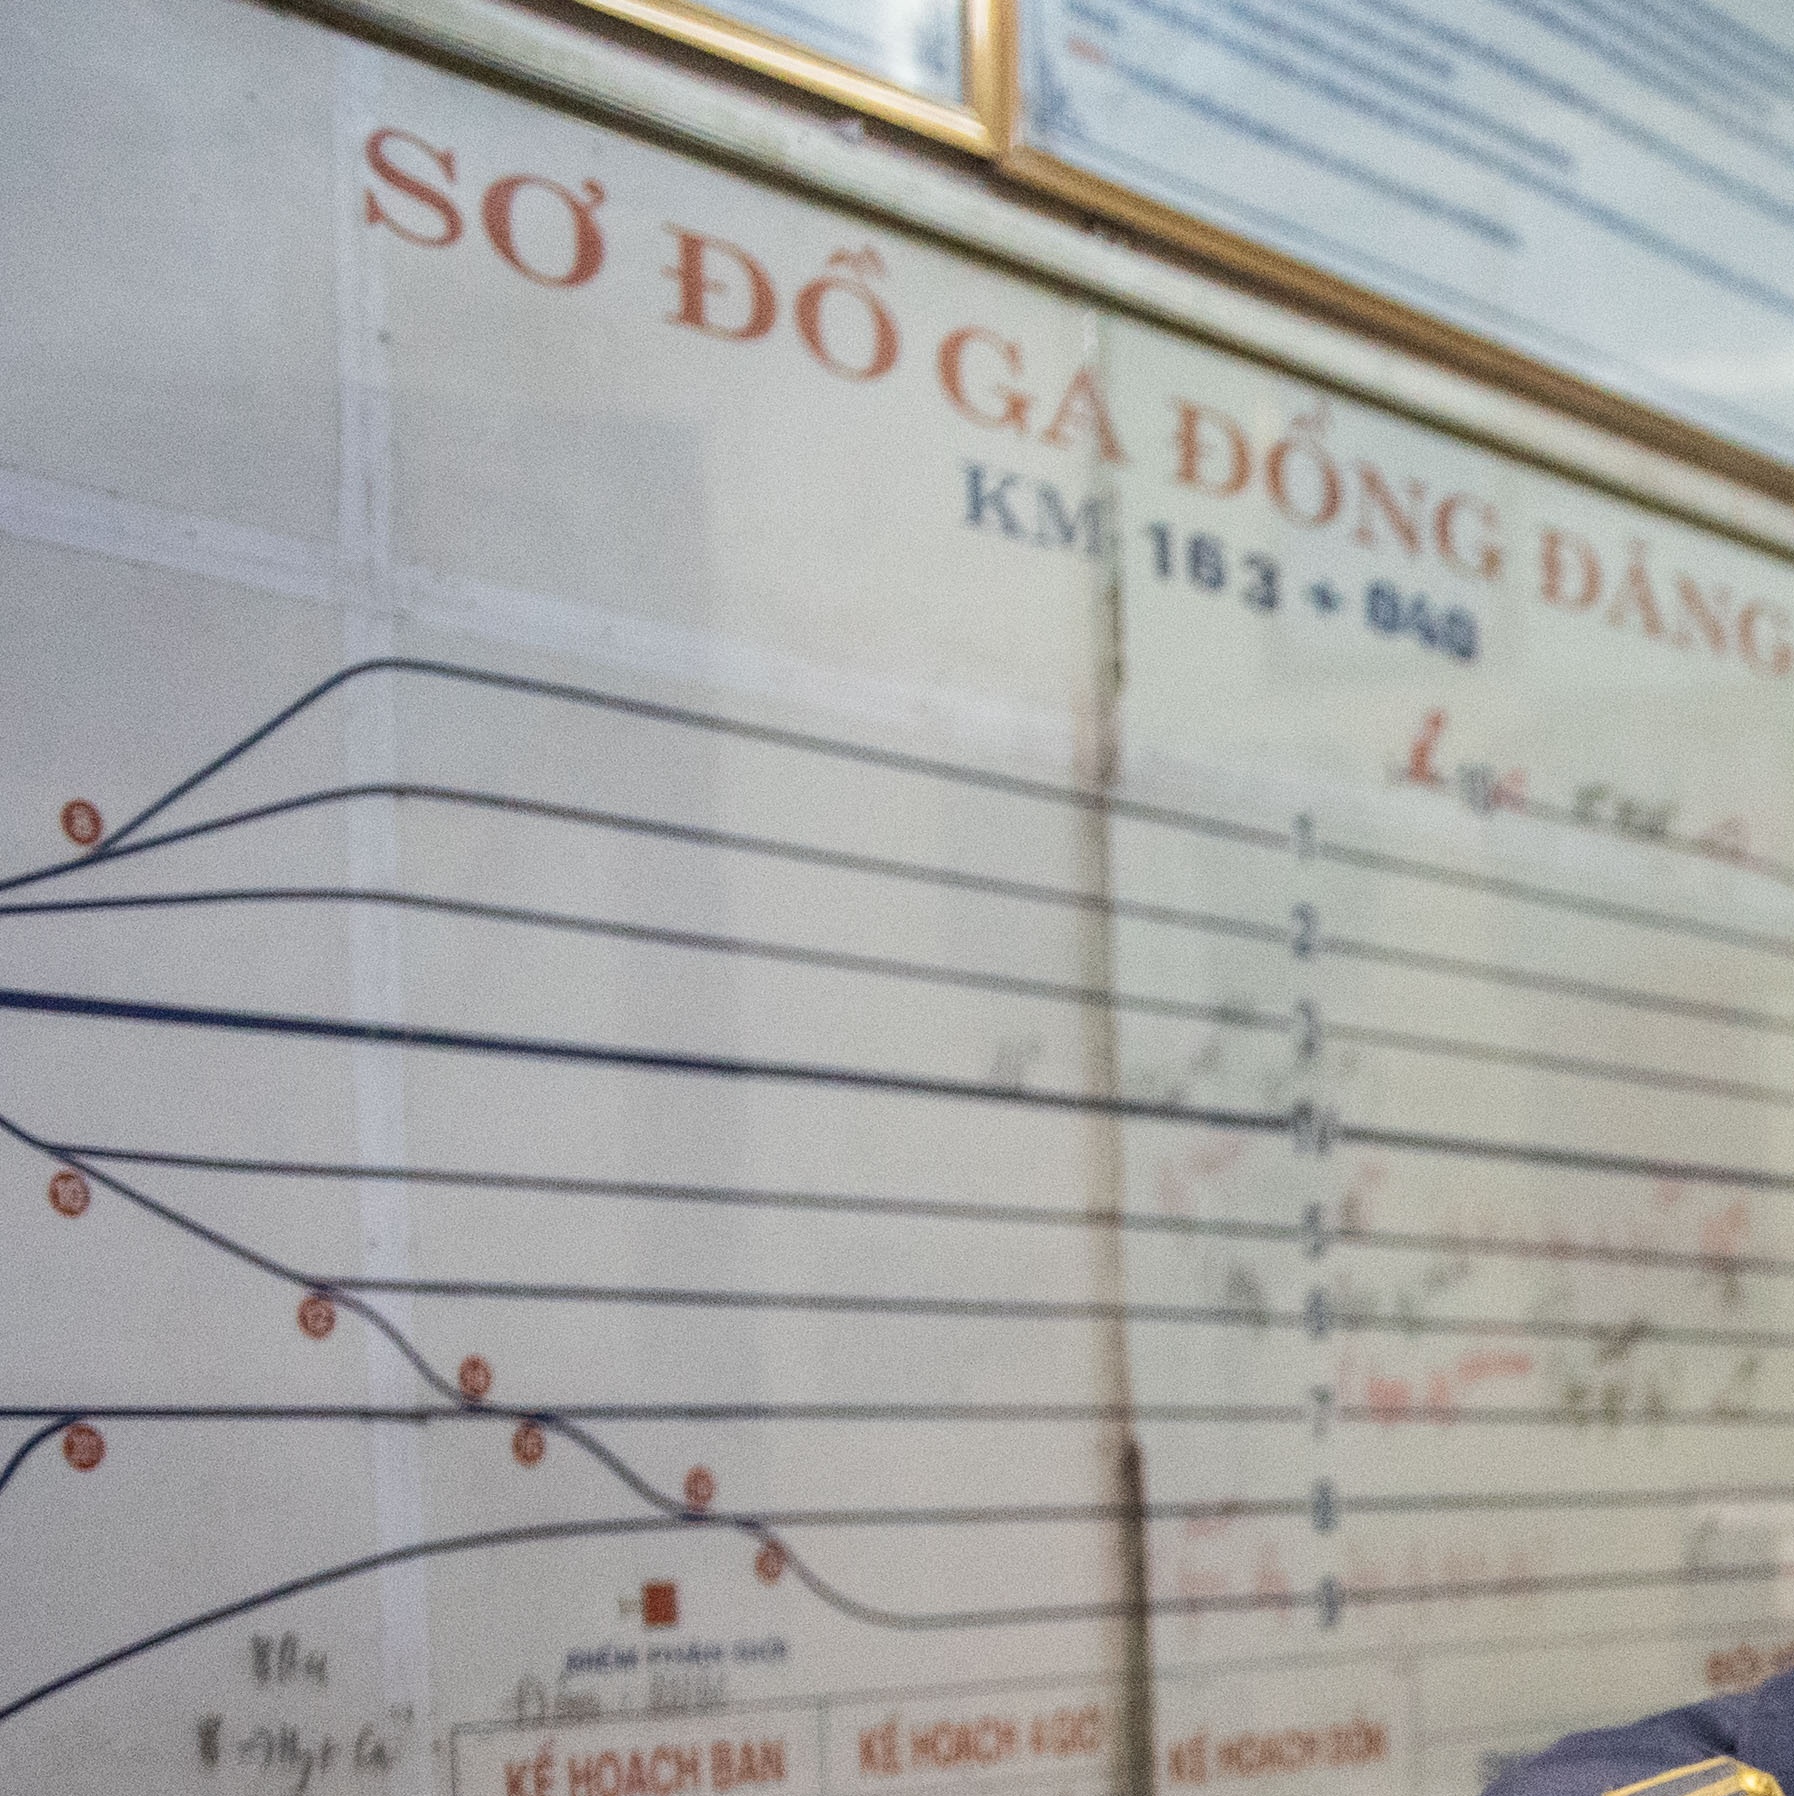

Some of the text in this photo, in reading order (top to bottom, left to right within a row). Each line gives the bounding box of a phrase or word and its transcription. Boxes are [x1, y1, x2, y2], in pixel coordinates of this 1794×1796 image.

[363, 126, 1794, 678] SƠ ĐỒ GA ĐỒNG ĐĂNG
[962, 458, 1109, 558] KM
[711, 1736, 787, 1792] BAN
